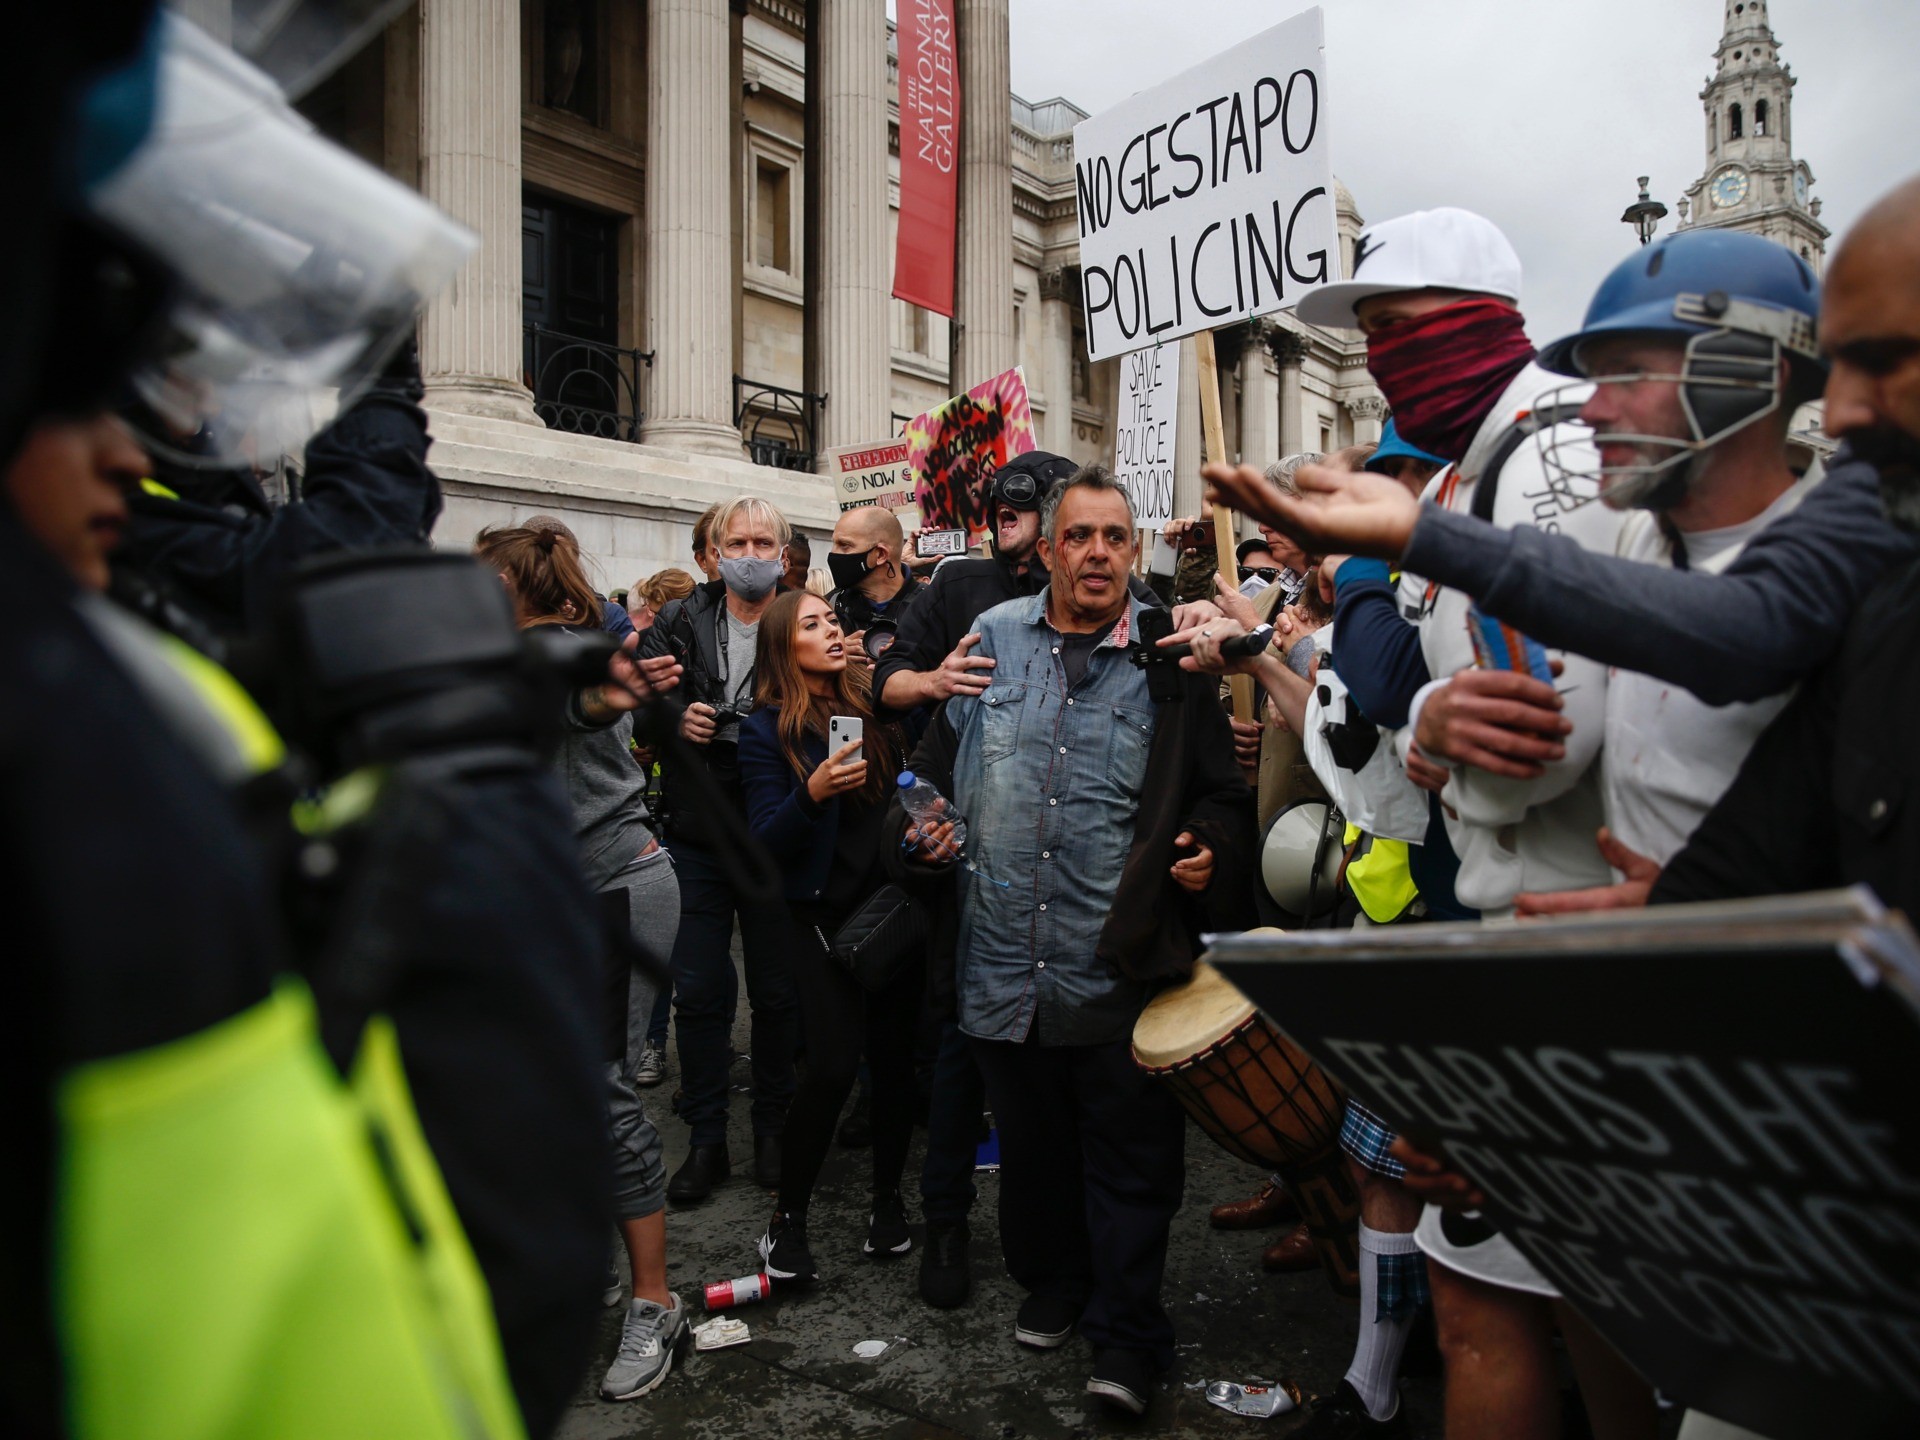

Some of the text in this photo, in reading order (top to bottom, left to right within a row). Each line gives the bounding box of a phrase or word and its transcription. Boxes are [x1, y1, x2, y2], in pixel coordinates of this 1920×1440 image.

[908, 75, 917, 109] THE
[916, 0, 934, 165] NATIONAL
[933, 0, 953, 173] GALLERY
[1076, 68, 1319, 239] NO GESTAPO
[1083, 186, 1328, 354] POLICING
[1129, 345, 1164, 392] SAVE
[1131, 389, 1155, 424] THE
[839, 444, 909, 472] FREEDOM
[1116, 420, 1168, 468] POLICE
[861, 470, 895, 490] NOW
[1114, 469, 1173, 519] SIONS
[1322, 1036, 1920, 1196] FEAR IS THE
[1515, 1226, 1648, 1321] OF
